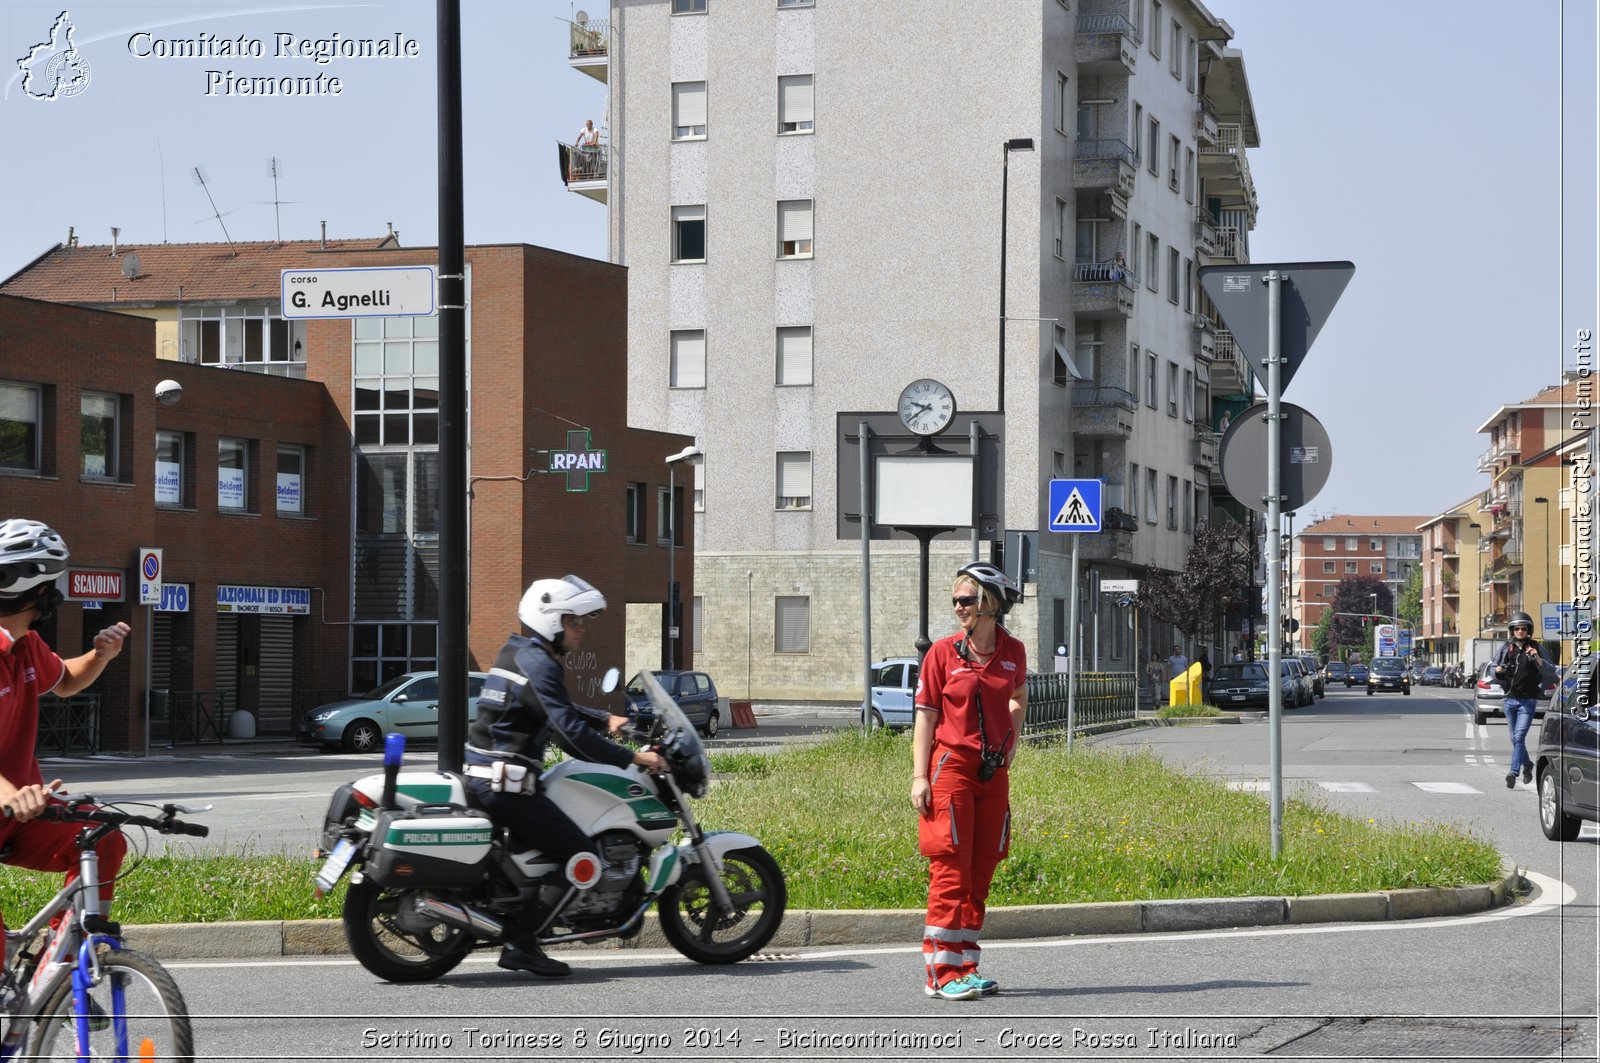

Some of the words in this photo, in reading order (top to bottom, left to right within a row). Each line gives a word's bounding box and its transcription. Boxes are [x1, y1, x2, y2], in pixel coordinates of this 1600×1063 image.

[291, 276, 317, 284] corso
[292, 291, 311, 308] G.
[321, 290, 390, 311] Agnelli
[551, 453, 604, 469] RPAN
[219, 481, 243, 491] Beldent
[278, 485, 299, 496] Beldent
[74, 575, 119, 594] SCAVOLINI
[268, 588, 279, 603] ED
[281, 589, 309, 604] ESTERI
[403, 833, 439, 843] POLIZIA
[441, 832, 492, 843] MUNICIPALE
